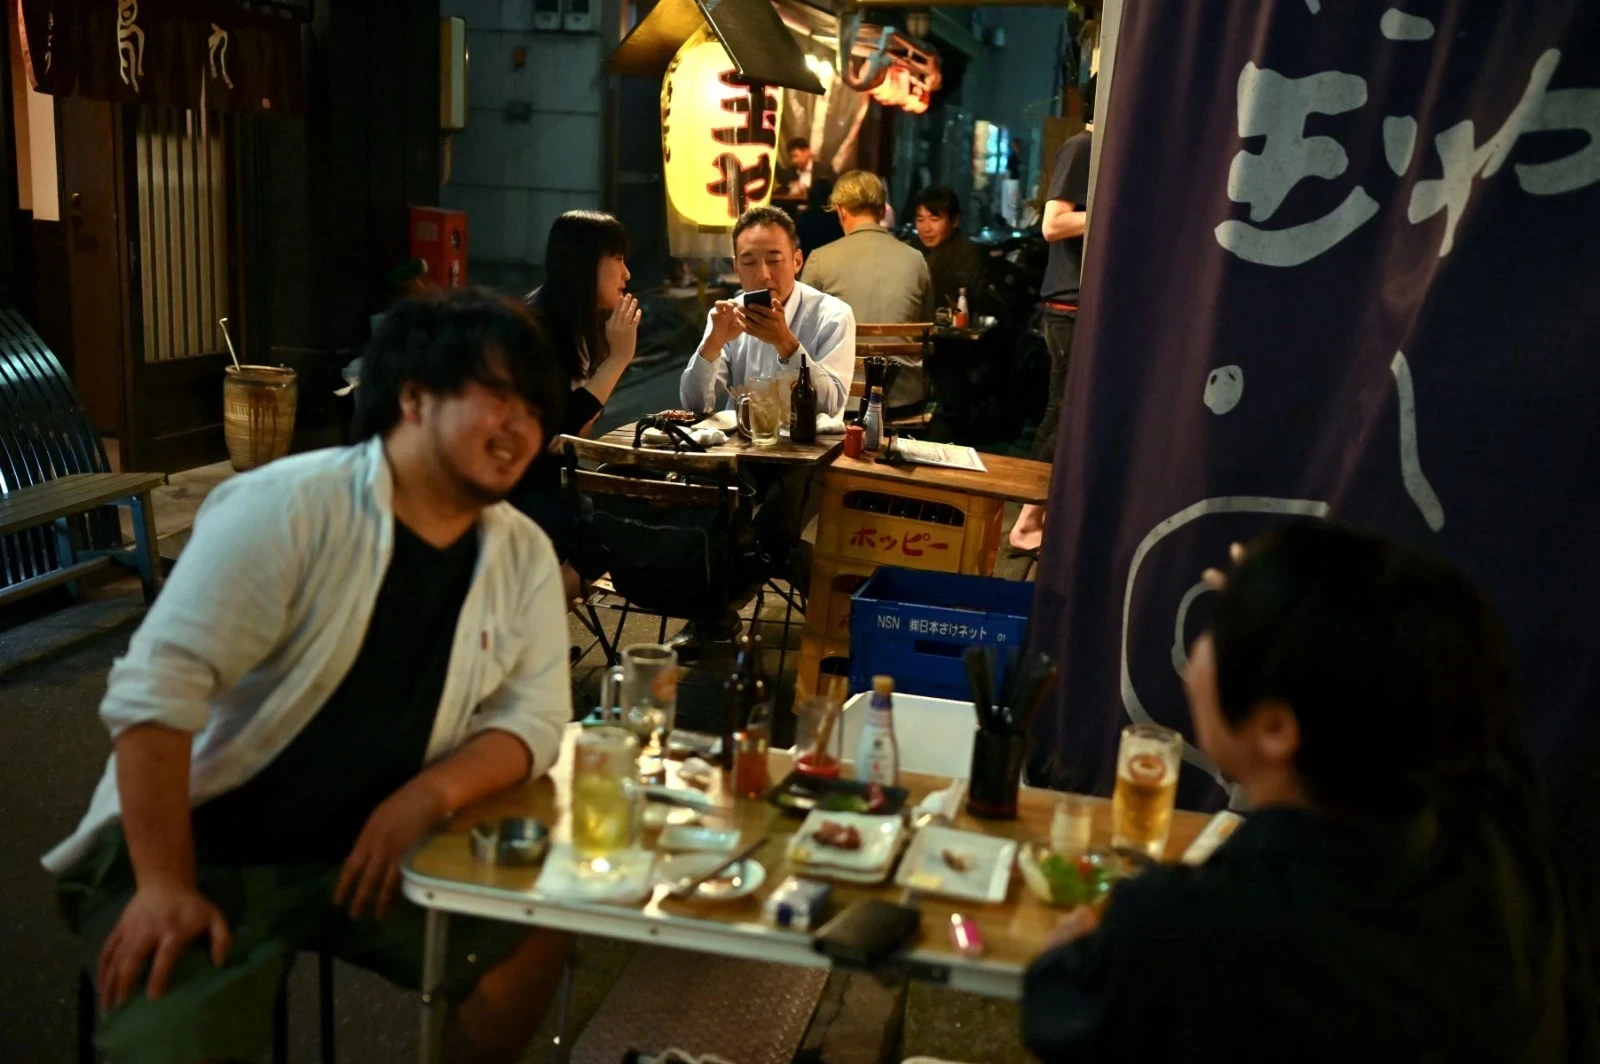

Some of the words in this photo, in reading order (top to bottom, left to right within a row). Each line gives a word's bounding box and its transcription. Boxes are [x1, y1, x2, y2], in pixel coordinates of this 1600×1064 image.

[850, 525, 949, 557] ホッピー
[877, 614, 901, 631] NSN
[997, 633, 1007, 642] 01
